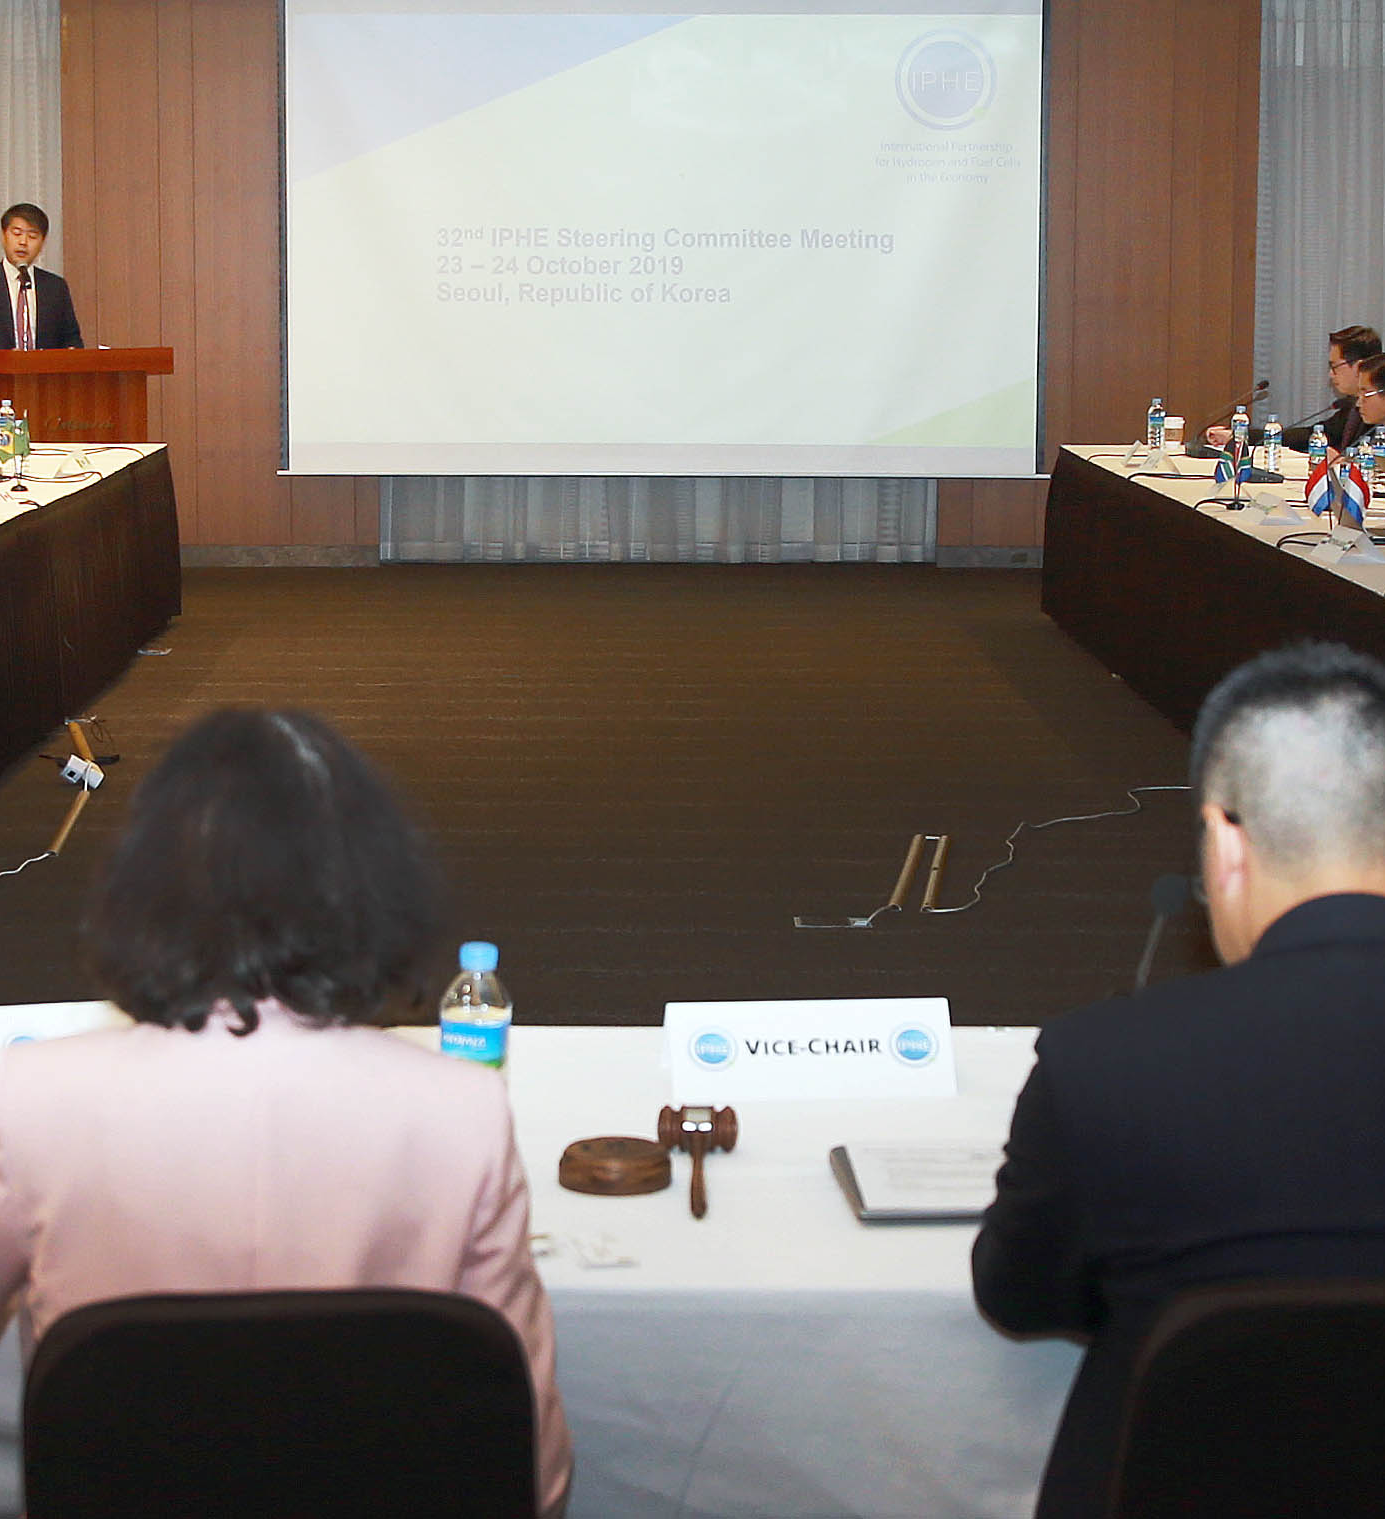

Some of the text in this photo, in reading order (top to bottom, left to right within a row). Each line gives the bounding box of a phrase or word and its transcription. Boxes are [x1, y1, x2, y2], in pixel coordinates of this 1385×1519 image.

[911, 71, 980, 92] IPHE
[436, 227, 895, 254] 32nd IPHE Steering Committee Meeting
[436, 255, 463, 275] 23
[492, 256, 520, 275] 24
[526, 255, 622, 275] October
[629, 256, 684, 275] 2019
[436, 282, 731, 307] Seoul, Republic of Korea
[744, 1037, 883, 1057] VICE-CHAIR
